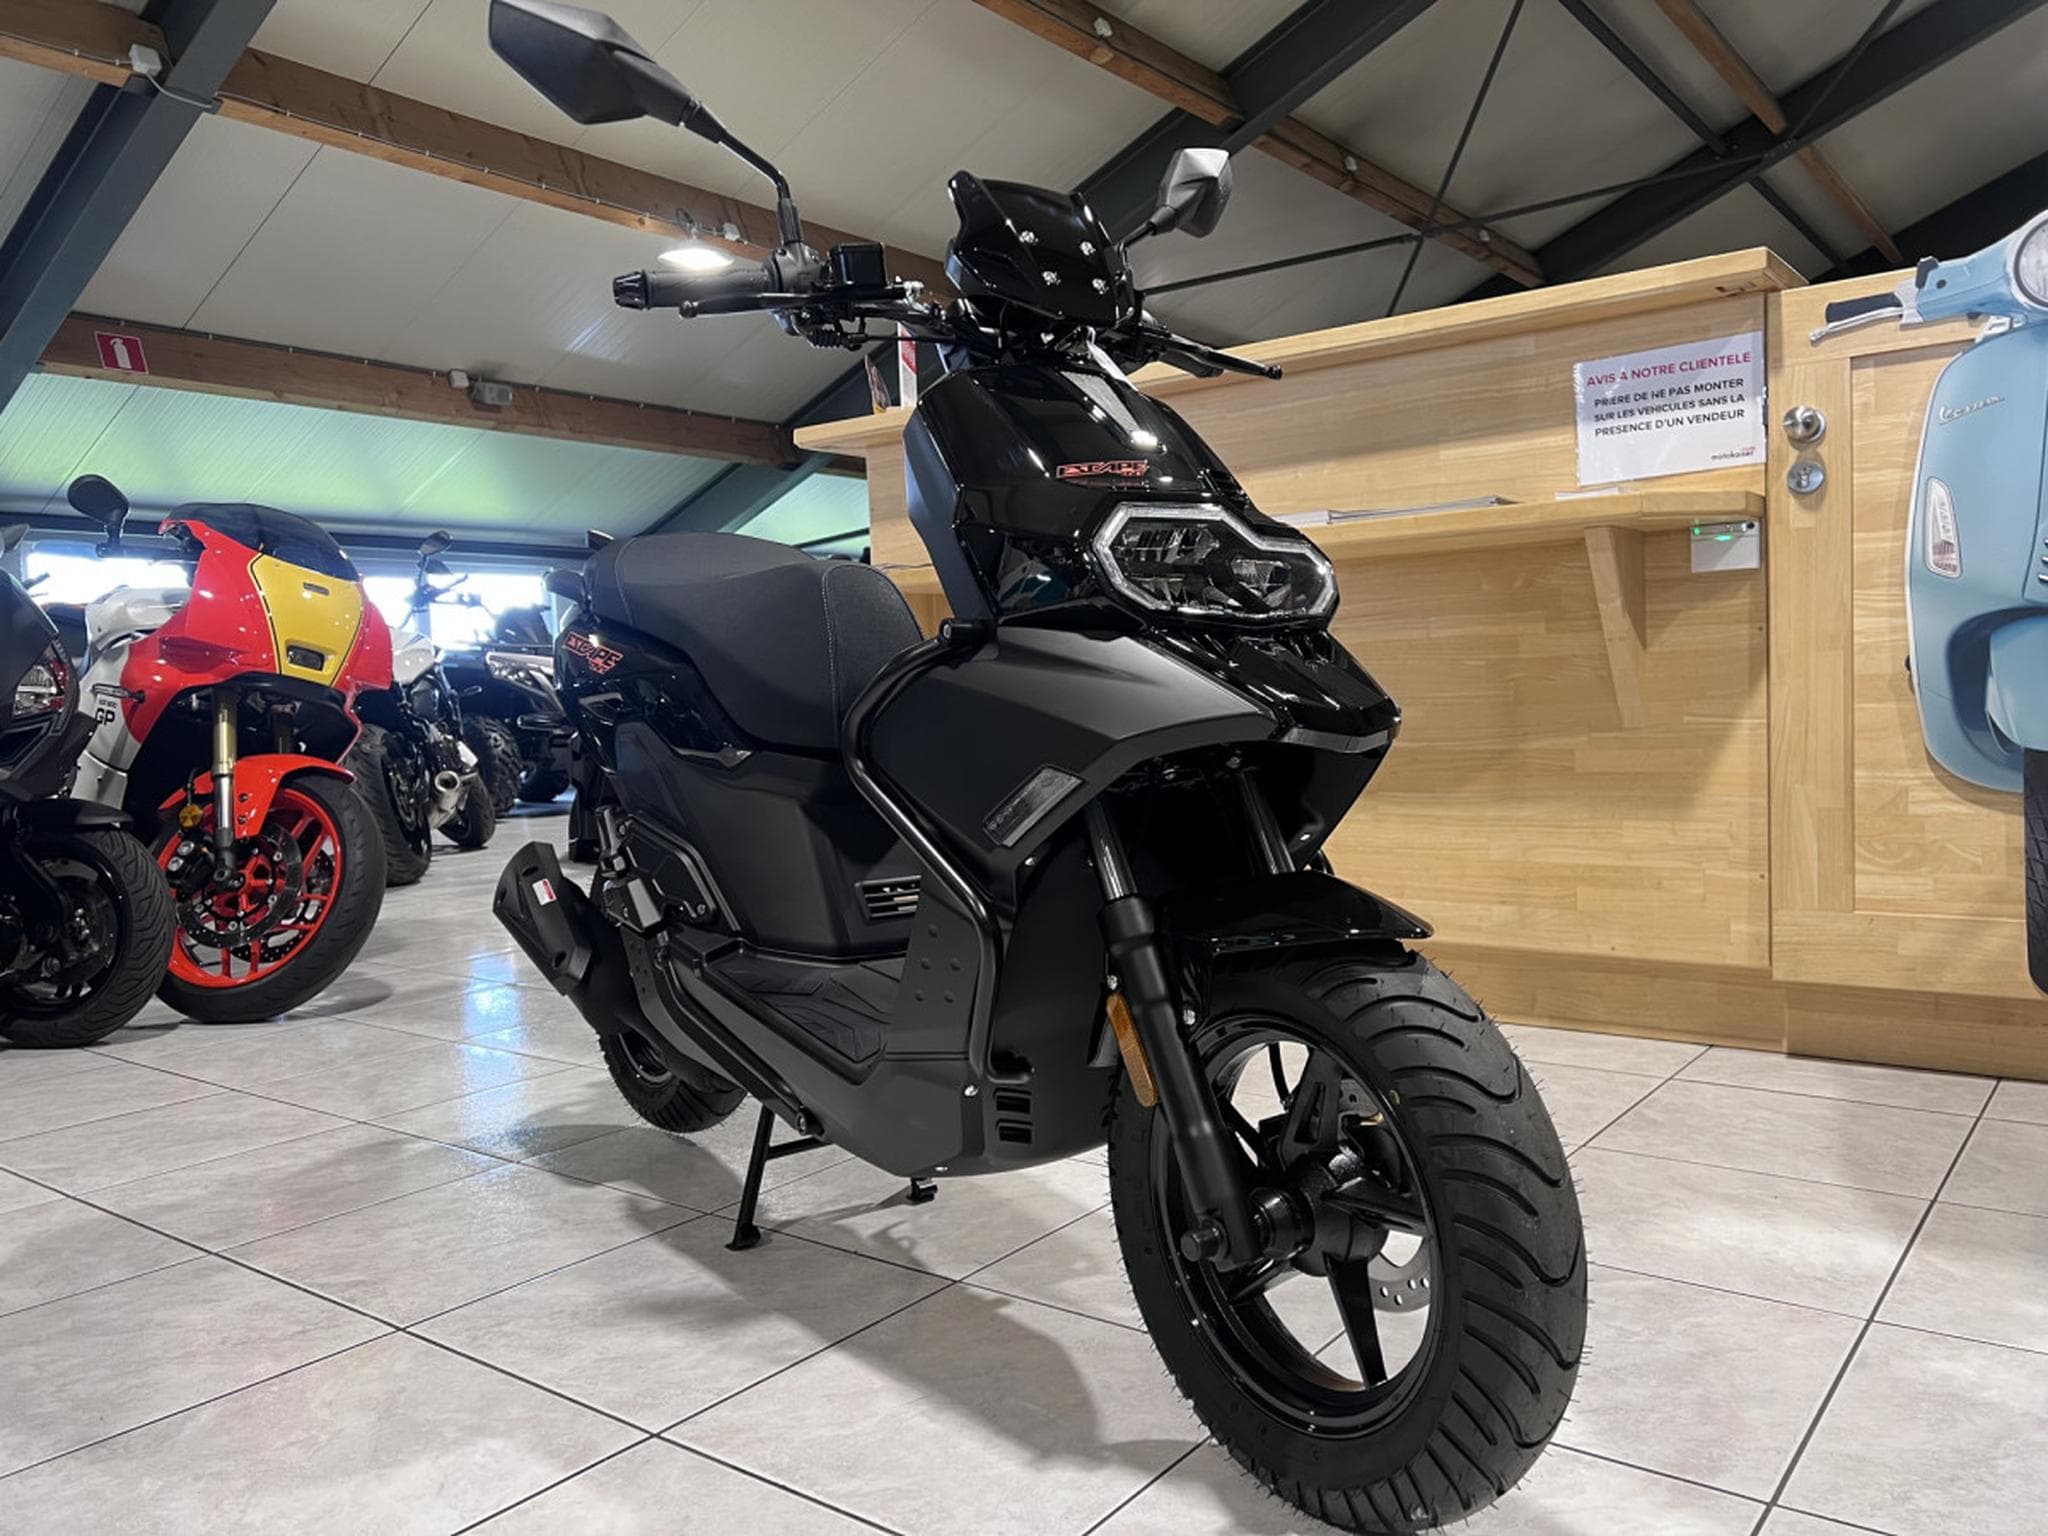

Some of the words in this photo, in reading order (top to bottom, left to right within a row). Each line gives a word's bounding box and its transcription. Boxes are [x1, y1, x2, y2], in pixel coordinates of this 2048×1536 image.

[1586, 373, 1616, 387] AVIS
[1631, 363, 1675, 380] NOTRE
[1679, 352, 1752, 373] CLIENTELE
[1594, 393, 1631, 408] PRIERE
[1633, 391, 1649, 403] DE
[1651, 389, 1667, 400] NE
[1669, 385, 1691, 397] PAS
[1694, 378, 1744, 393] MONTER
[1594, 411, 1615, 423] SUR
[1617, 409, 1635, 420] LES
[1637, 400, 1696, 416] VEHICULES
[1699, 394, 1728, 407] SANS
[1730, 393, 1745, 404] LA
[1595, 420, 1652, 437] PRESENCE
[1655, 416, 1684, 430] D'UN
[1686, 408, 1745, 425] VENDEUR
[95, 708, 116, 726] GP
